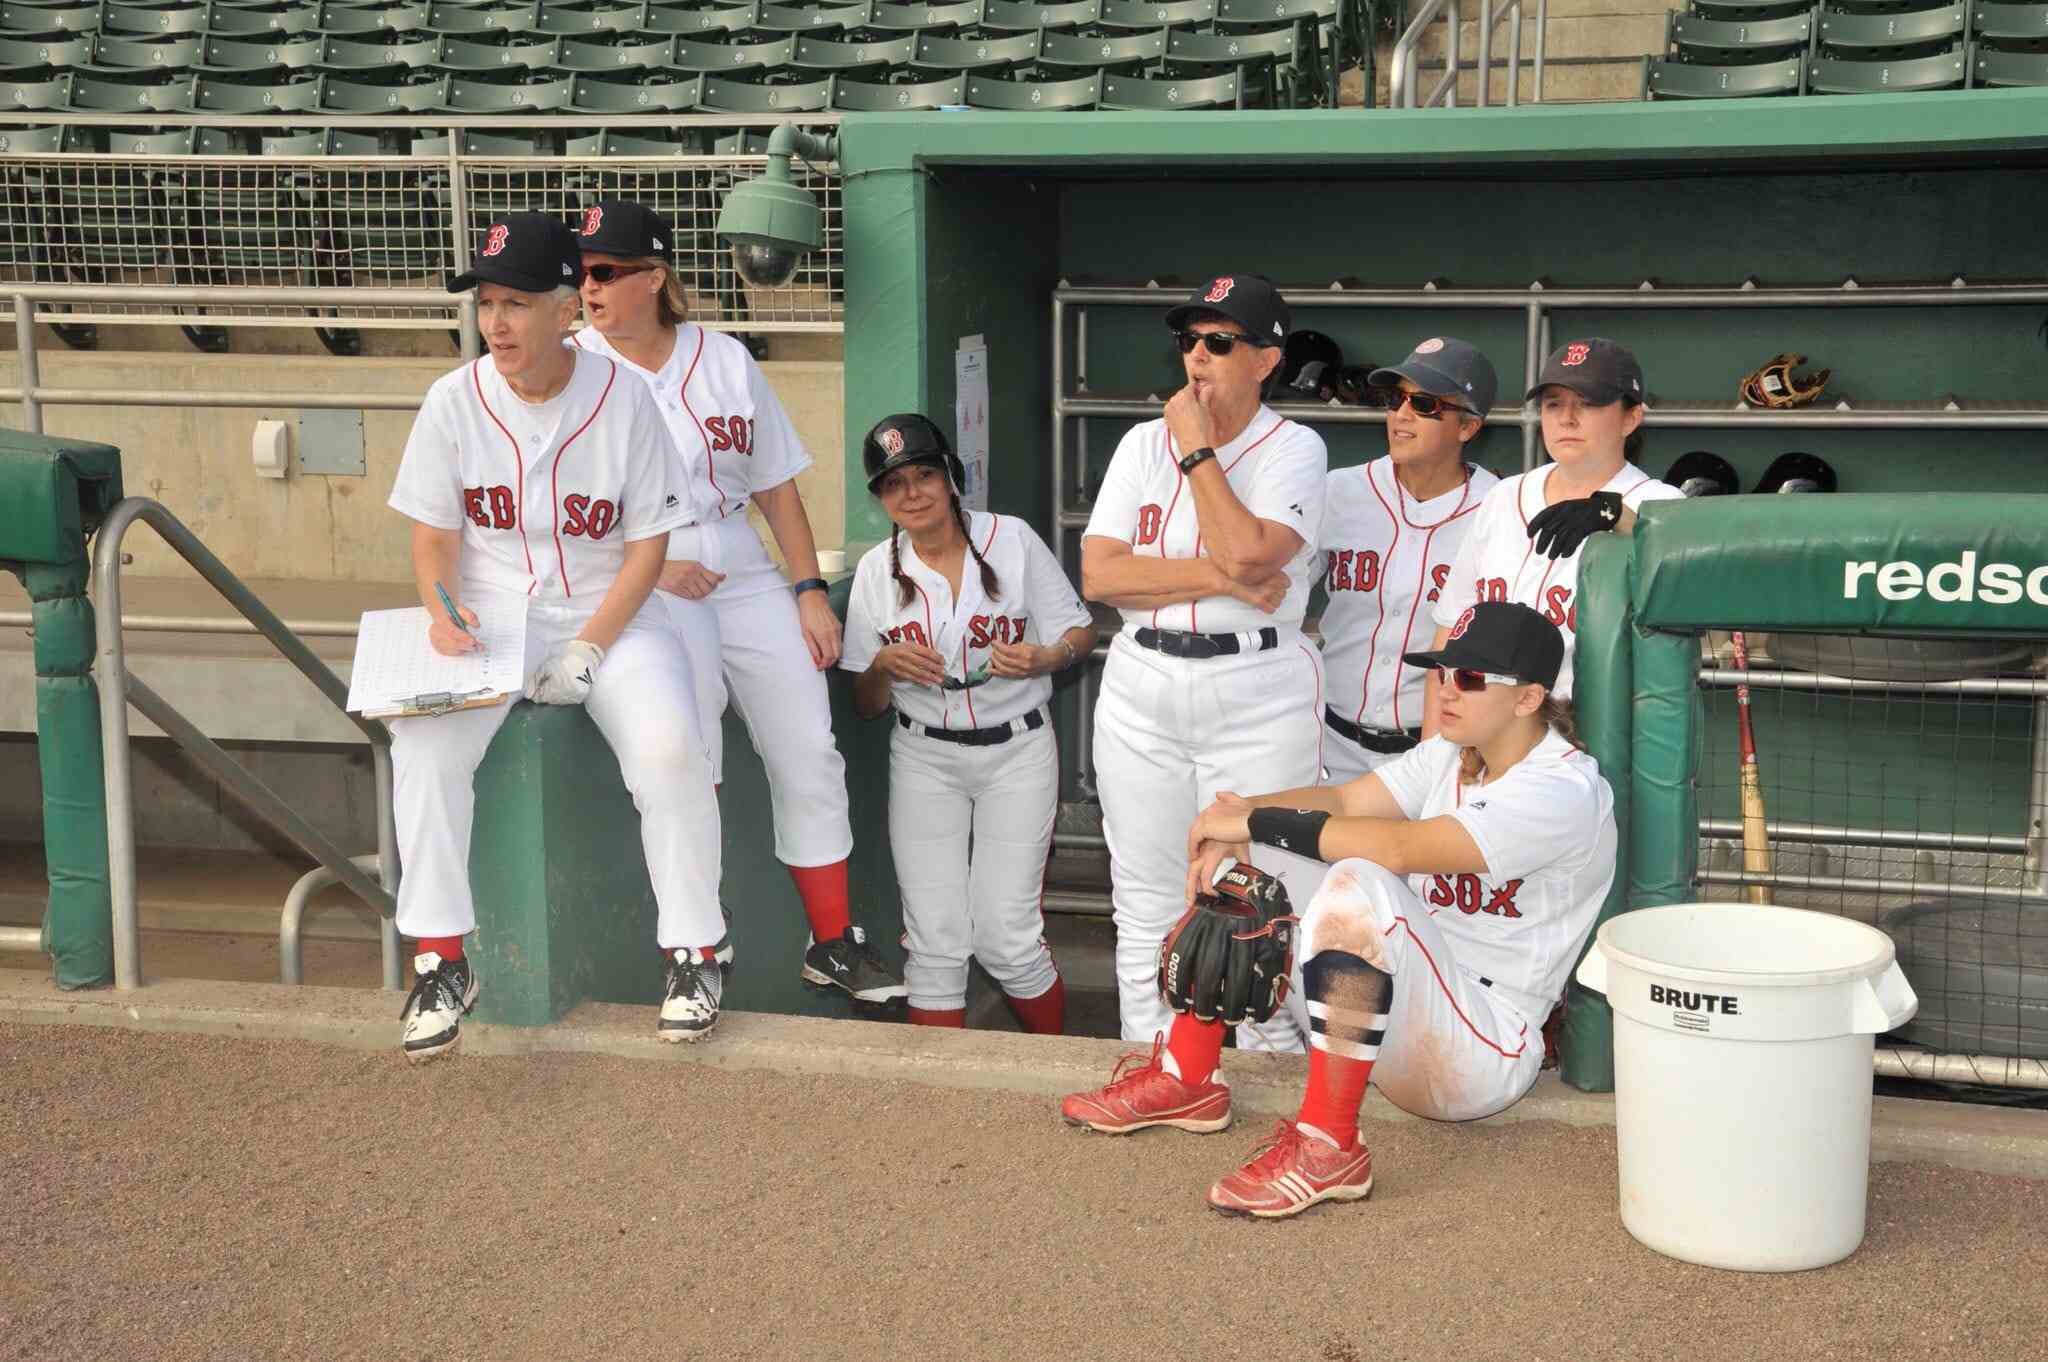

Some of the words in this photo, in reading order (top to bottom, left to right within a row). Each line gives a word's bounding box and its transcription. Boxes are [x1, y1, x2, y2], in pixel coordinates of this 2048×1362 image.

[483, 223, 509, 256] B
[1204, 276, 1235, 303] B
[1561, 341, 1589, 366] B
[464, 485, 516, 530] ED
[562, 493, 623, 540] SO
[1430, 873, 1525, 918] SOX
[1650, 983, 1738, 1015] BRUTE
